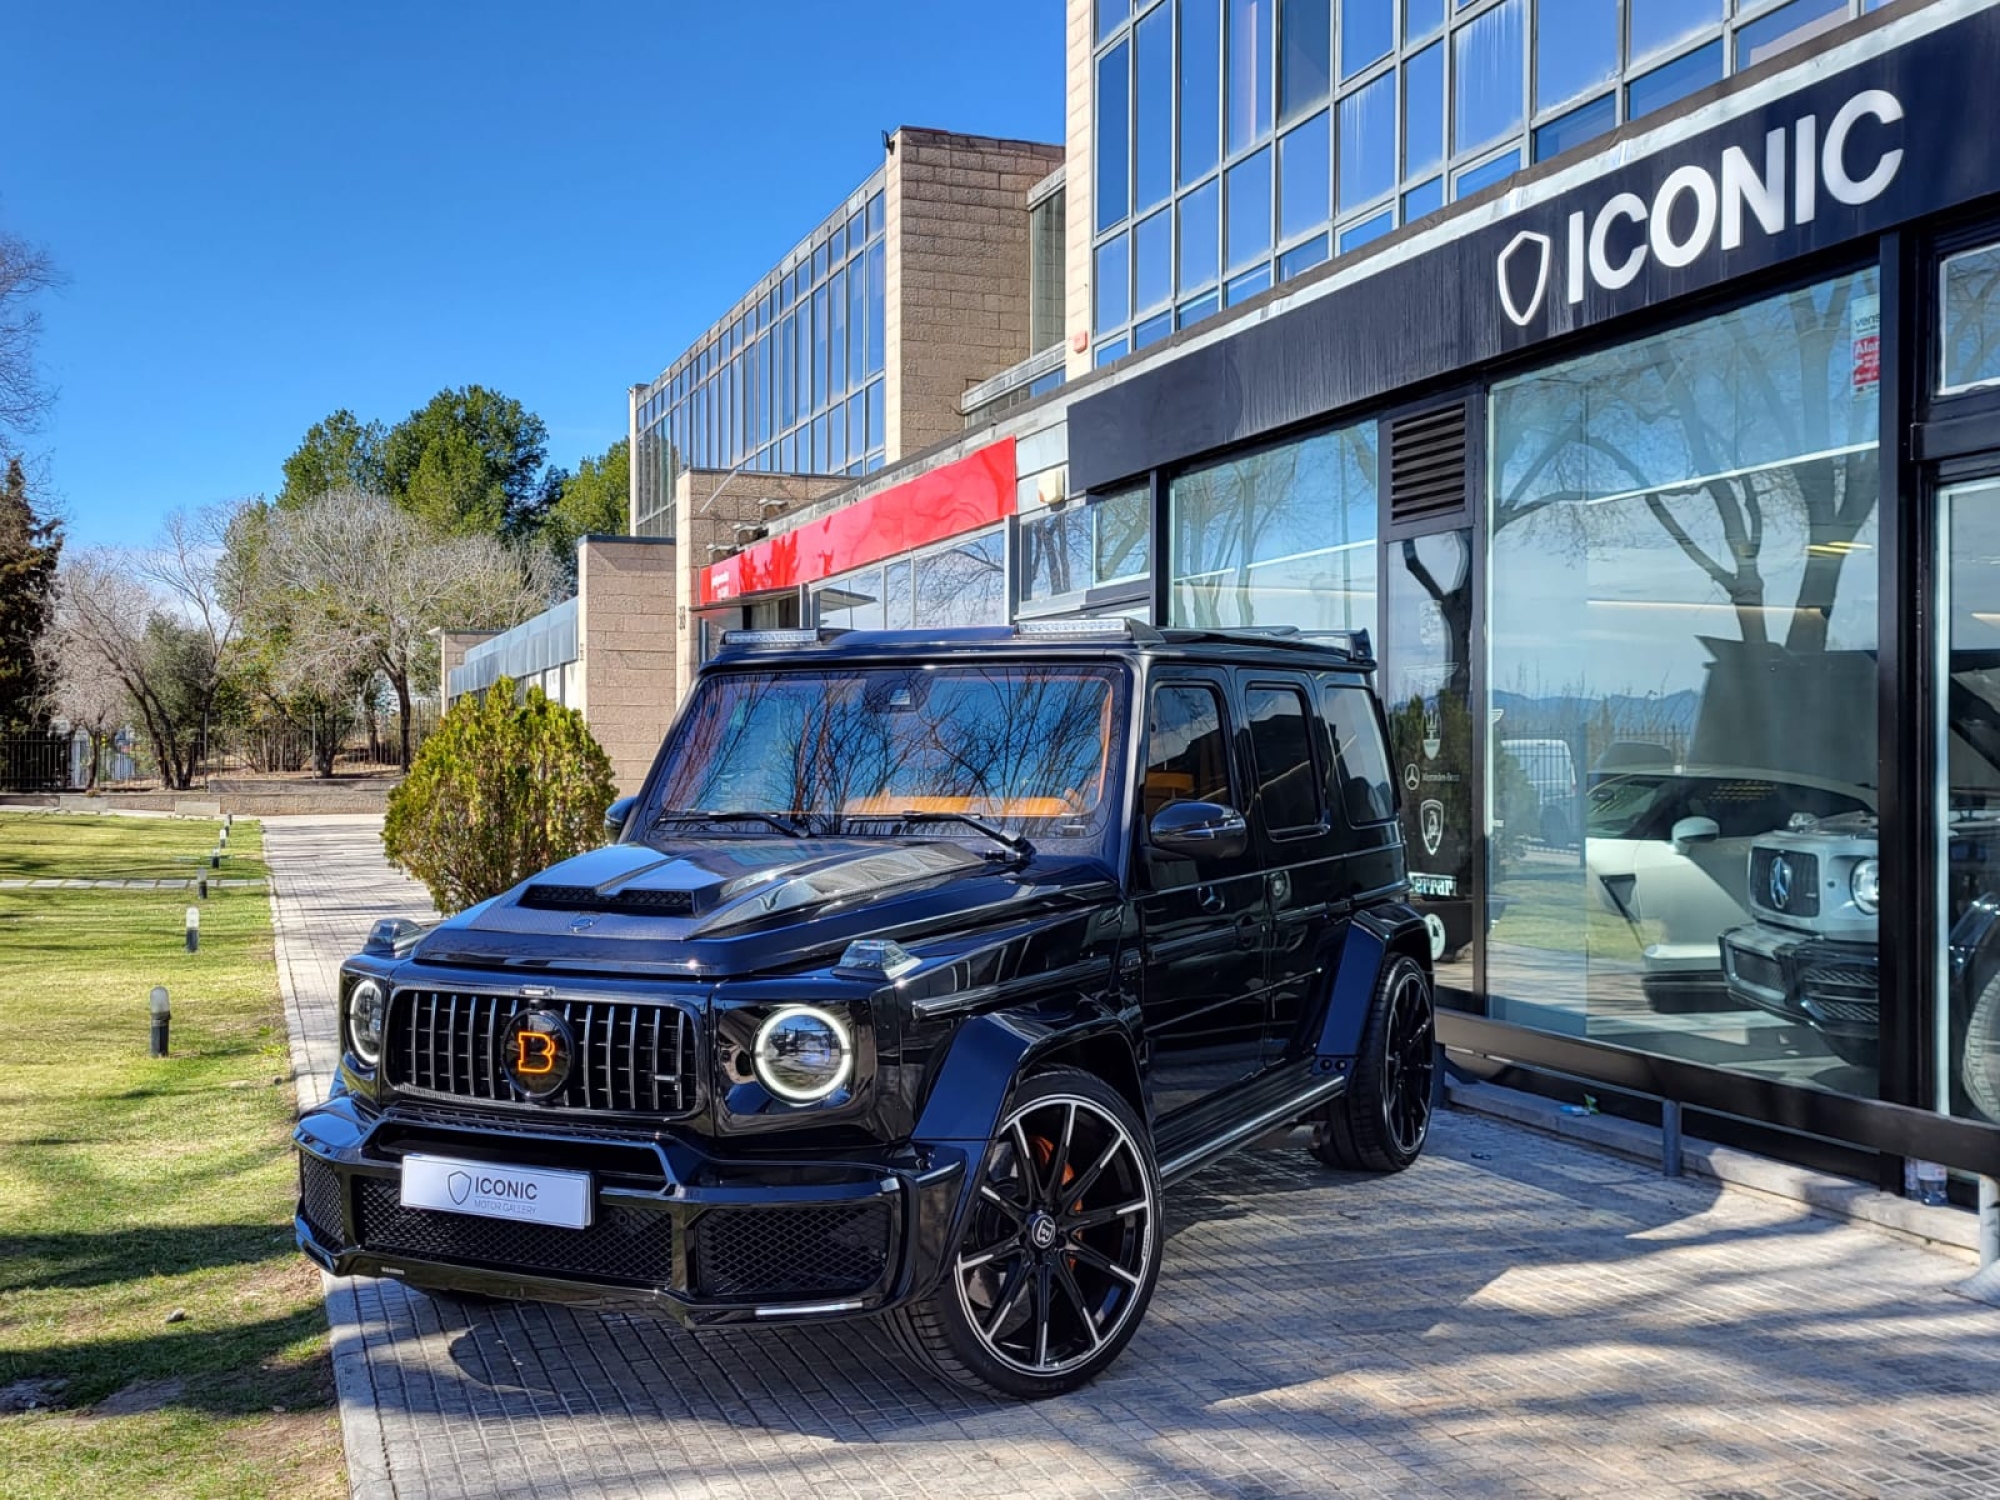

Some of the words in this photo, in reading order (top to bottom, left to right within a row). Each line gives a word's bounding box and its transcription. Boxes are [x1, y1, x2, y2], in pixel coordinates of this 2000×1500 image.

[1567, 89, 1905, 305] ICONIC
[475, 1176, 537, 1200] ICONIC
[475, 1199, 502, 1210] MOTOR
[503, 1202, 537, 1215] GALLERY
